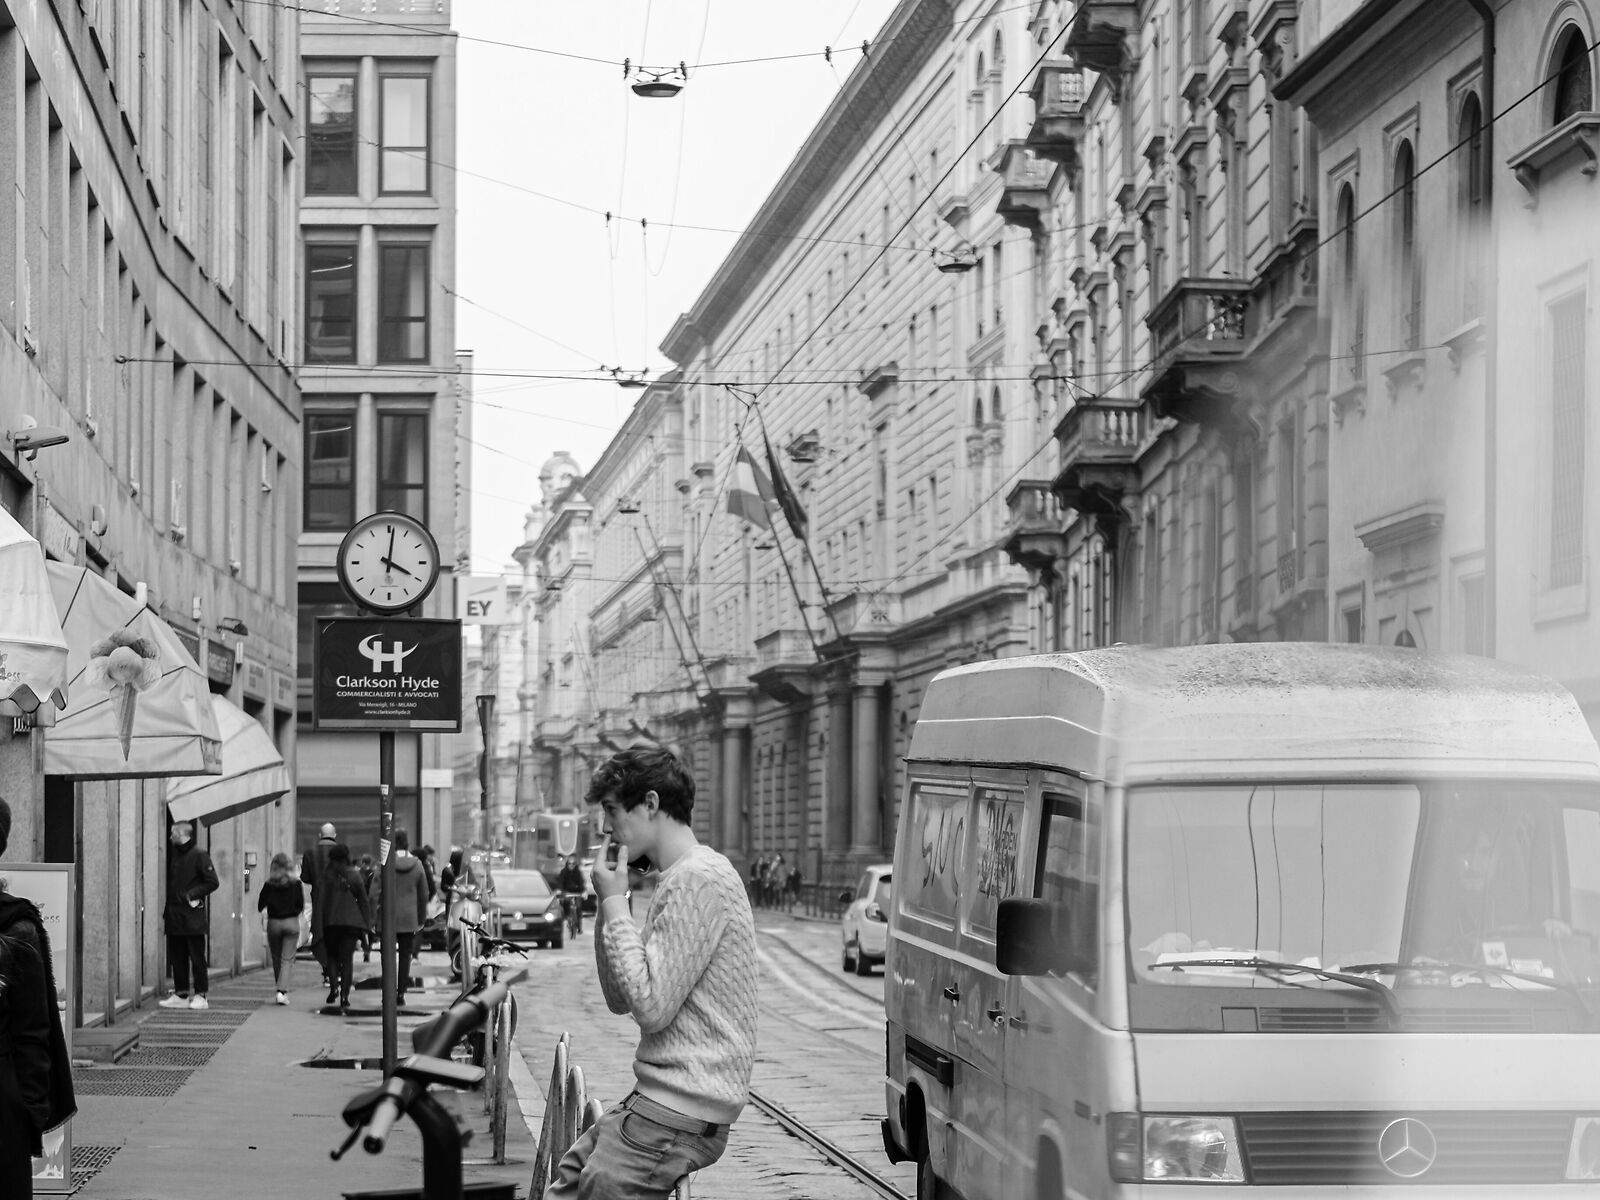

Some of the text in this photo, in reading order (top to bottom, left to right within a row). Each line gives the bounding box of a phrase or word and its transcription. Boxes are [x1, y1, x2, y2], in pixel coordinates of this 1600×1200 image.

[467, 600, 493, 617] EY
[336, 675, 440, 692] Clarkson Hyde
